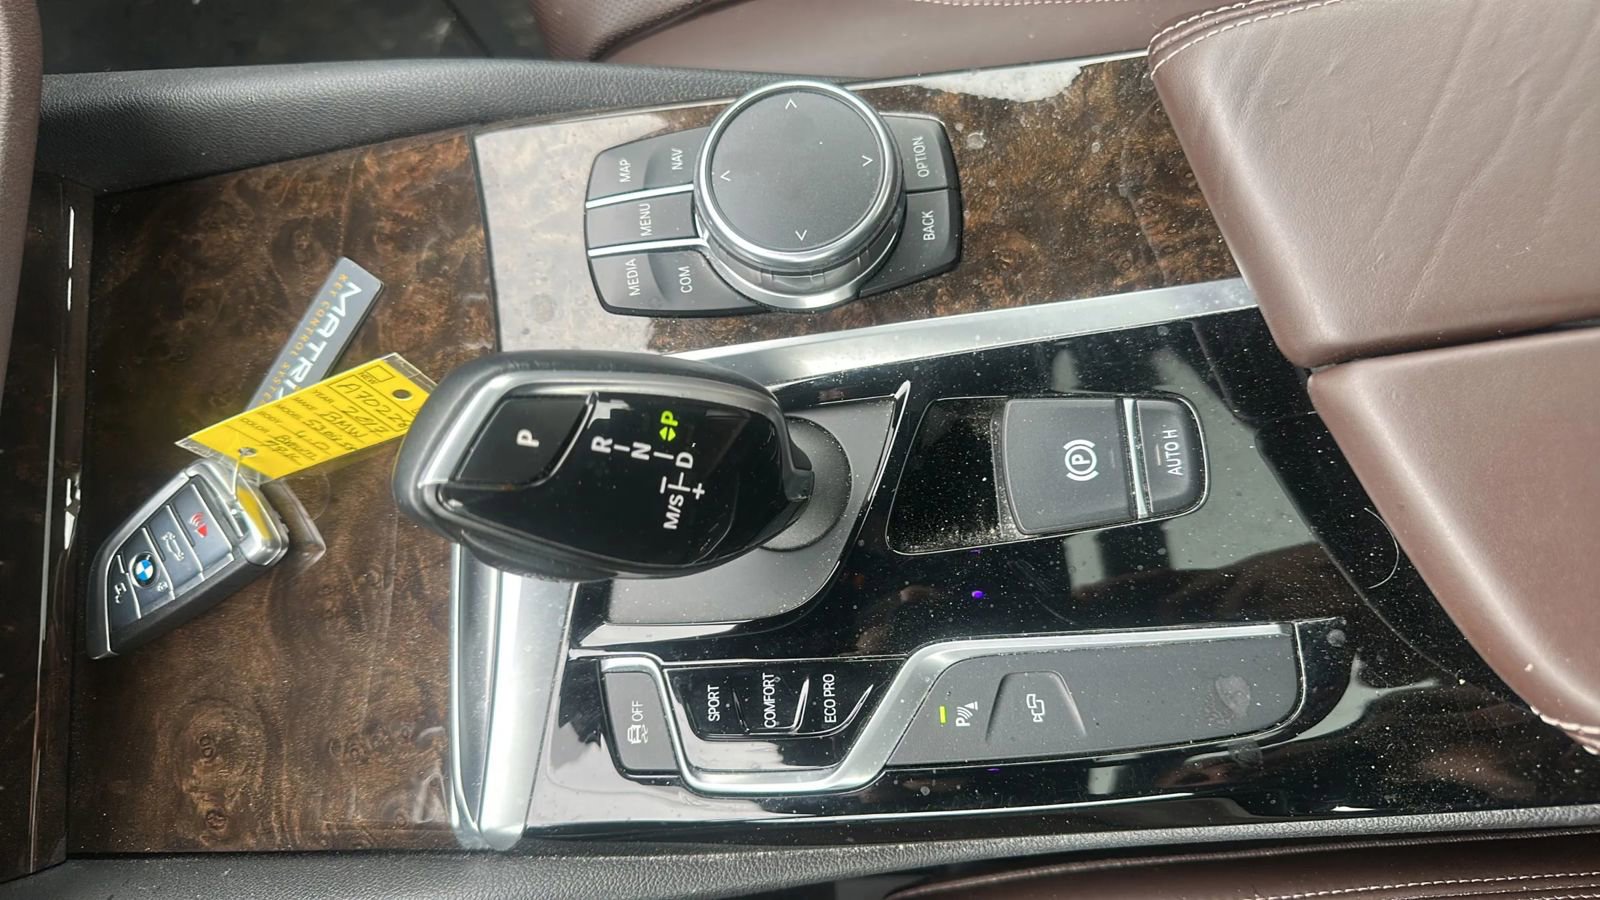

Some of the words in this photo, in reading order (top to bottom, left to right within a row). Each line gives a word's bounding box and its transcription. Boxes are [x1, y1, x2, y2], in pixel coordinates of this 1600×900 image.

[671, 147, 684, 171] NAV
[917, 135, 928, 177] OPTION
[620, 159, 631, 183] MAP
[640, 203, 652, 237] MENU
[922, 209, 935, 241] BACK
[629, 258, 642, 296] MEDIA
[680, 265, 691, 293] COM
[289, 300, 331, 357] CONTROL
[358, 372, 379, 385] NEW
[311, 389, 335, 404] YEAR
[319, 411, 369, 438] BMW
[661, 410, 679, 427] P
[516, 428, 540, 448] P
[590, 435, 613, 454] R
[1162, 429, 1179, 439] H
[631, 442, 652, 461] N
[675, 452, 694, 469] D
[1164, 441, 1184, 476] AUTO
[663, 494, 684, 530] M/S
[823, 673, 835, 698] PRO
[632, 700, 644, 723] OFF
[708, 684, 720, 723] SPORT
[764, 672, 776, 728] COMFORT
[823, 700, 835, 724] ECO
